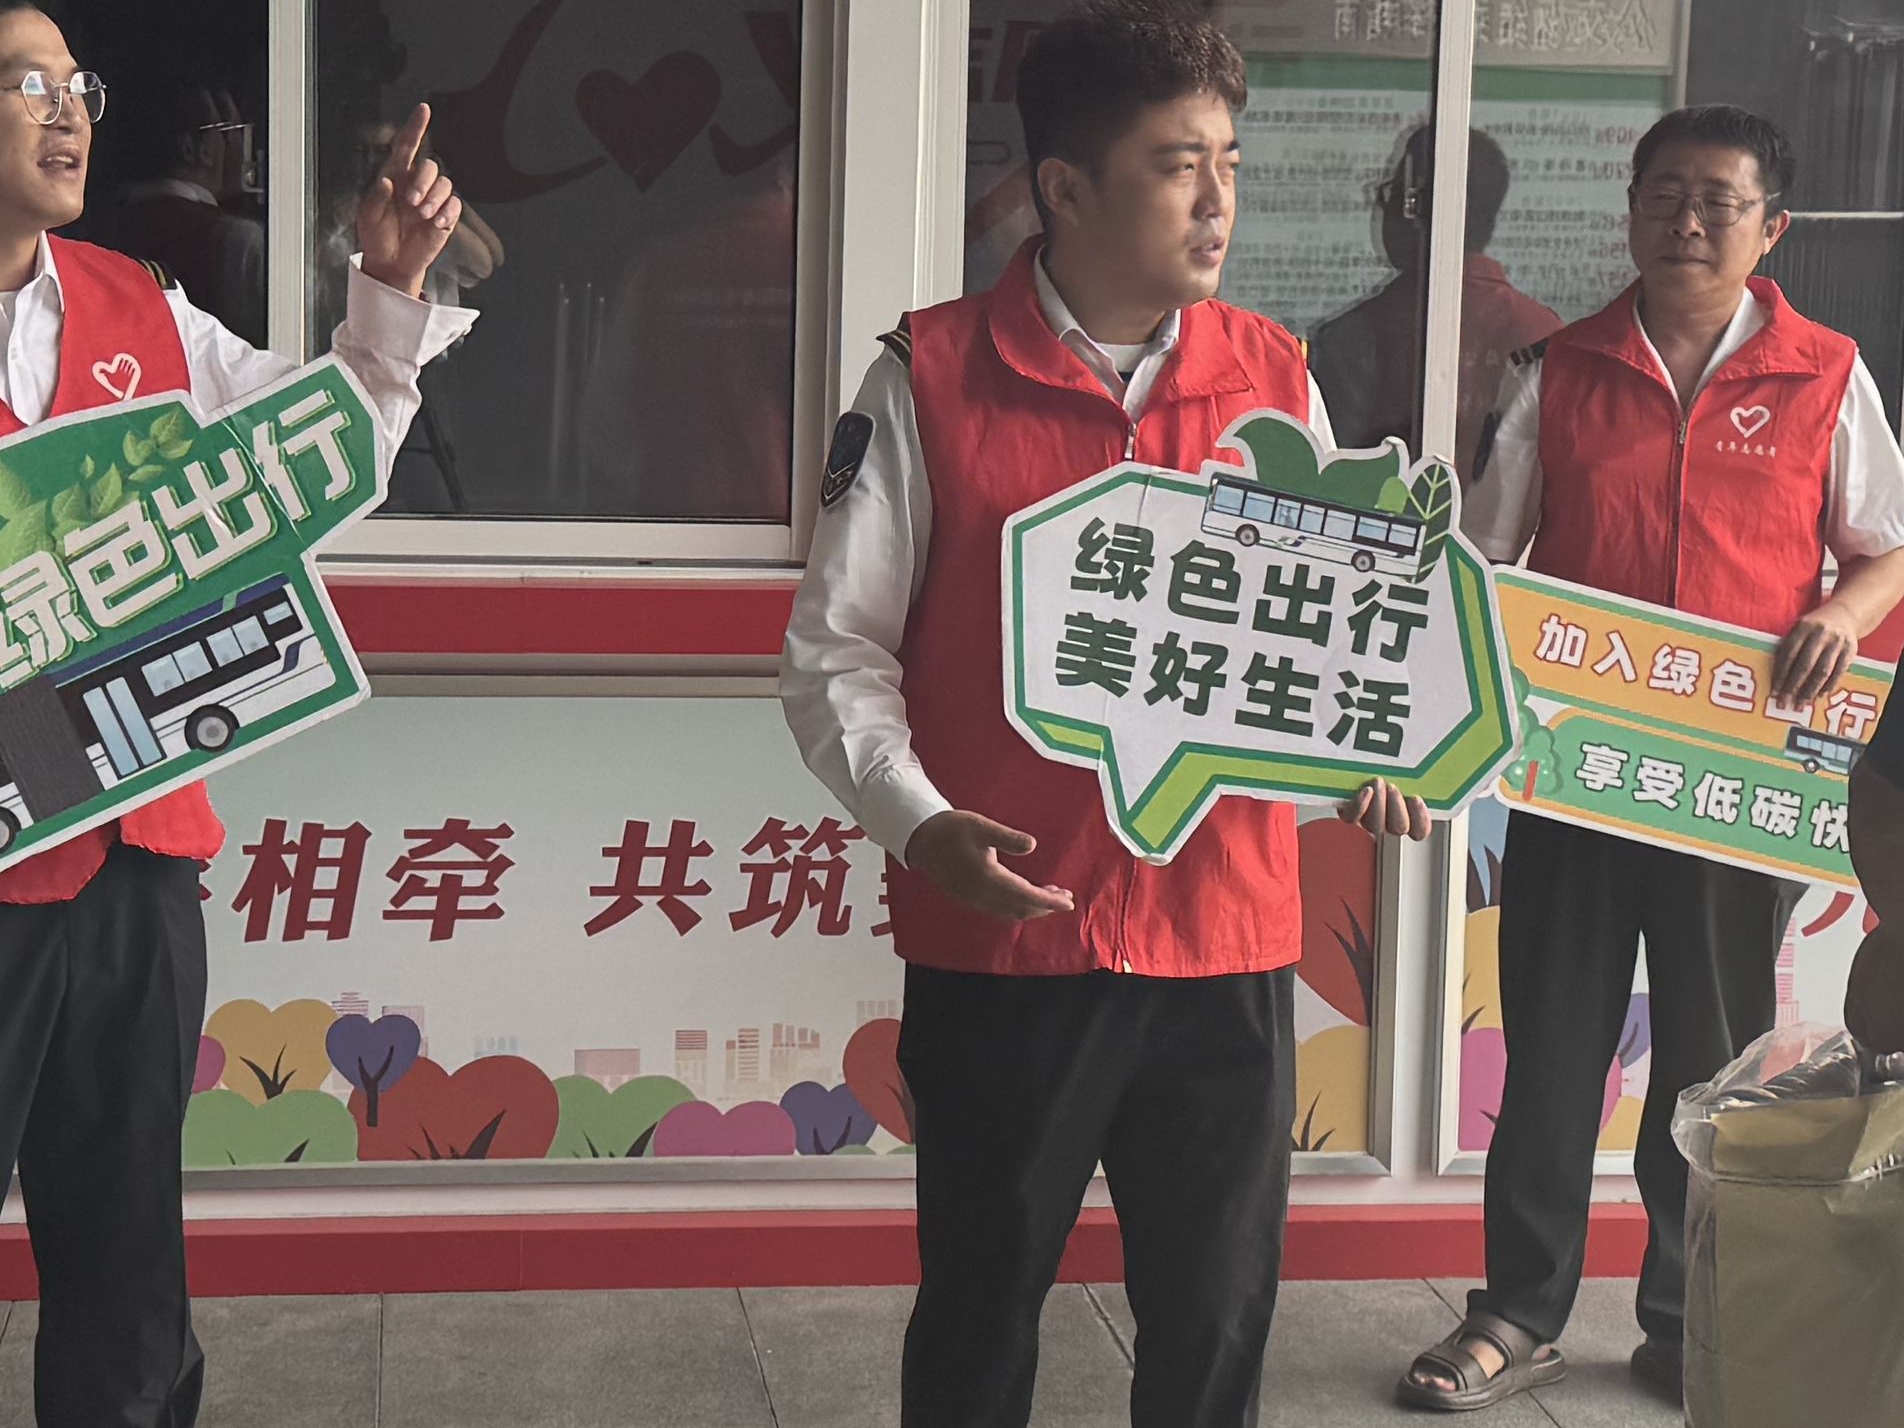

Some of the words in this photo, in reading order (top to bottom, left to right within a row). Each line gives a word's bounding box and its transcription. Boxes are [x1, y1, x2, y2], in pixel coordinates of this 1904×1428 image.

[1069, 516, 1430, 664] 绿色出行
[1054, 611, 1411, 759] 美好生活
[199, 816, 516, 944] 相牵
[582, 816, 899, 940] 共筑
